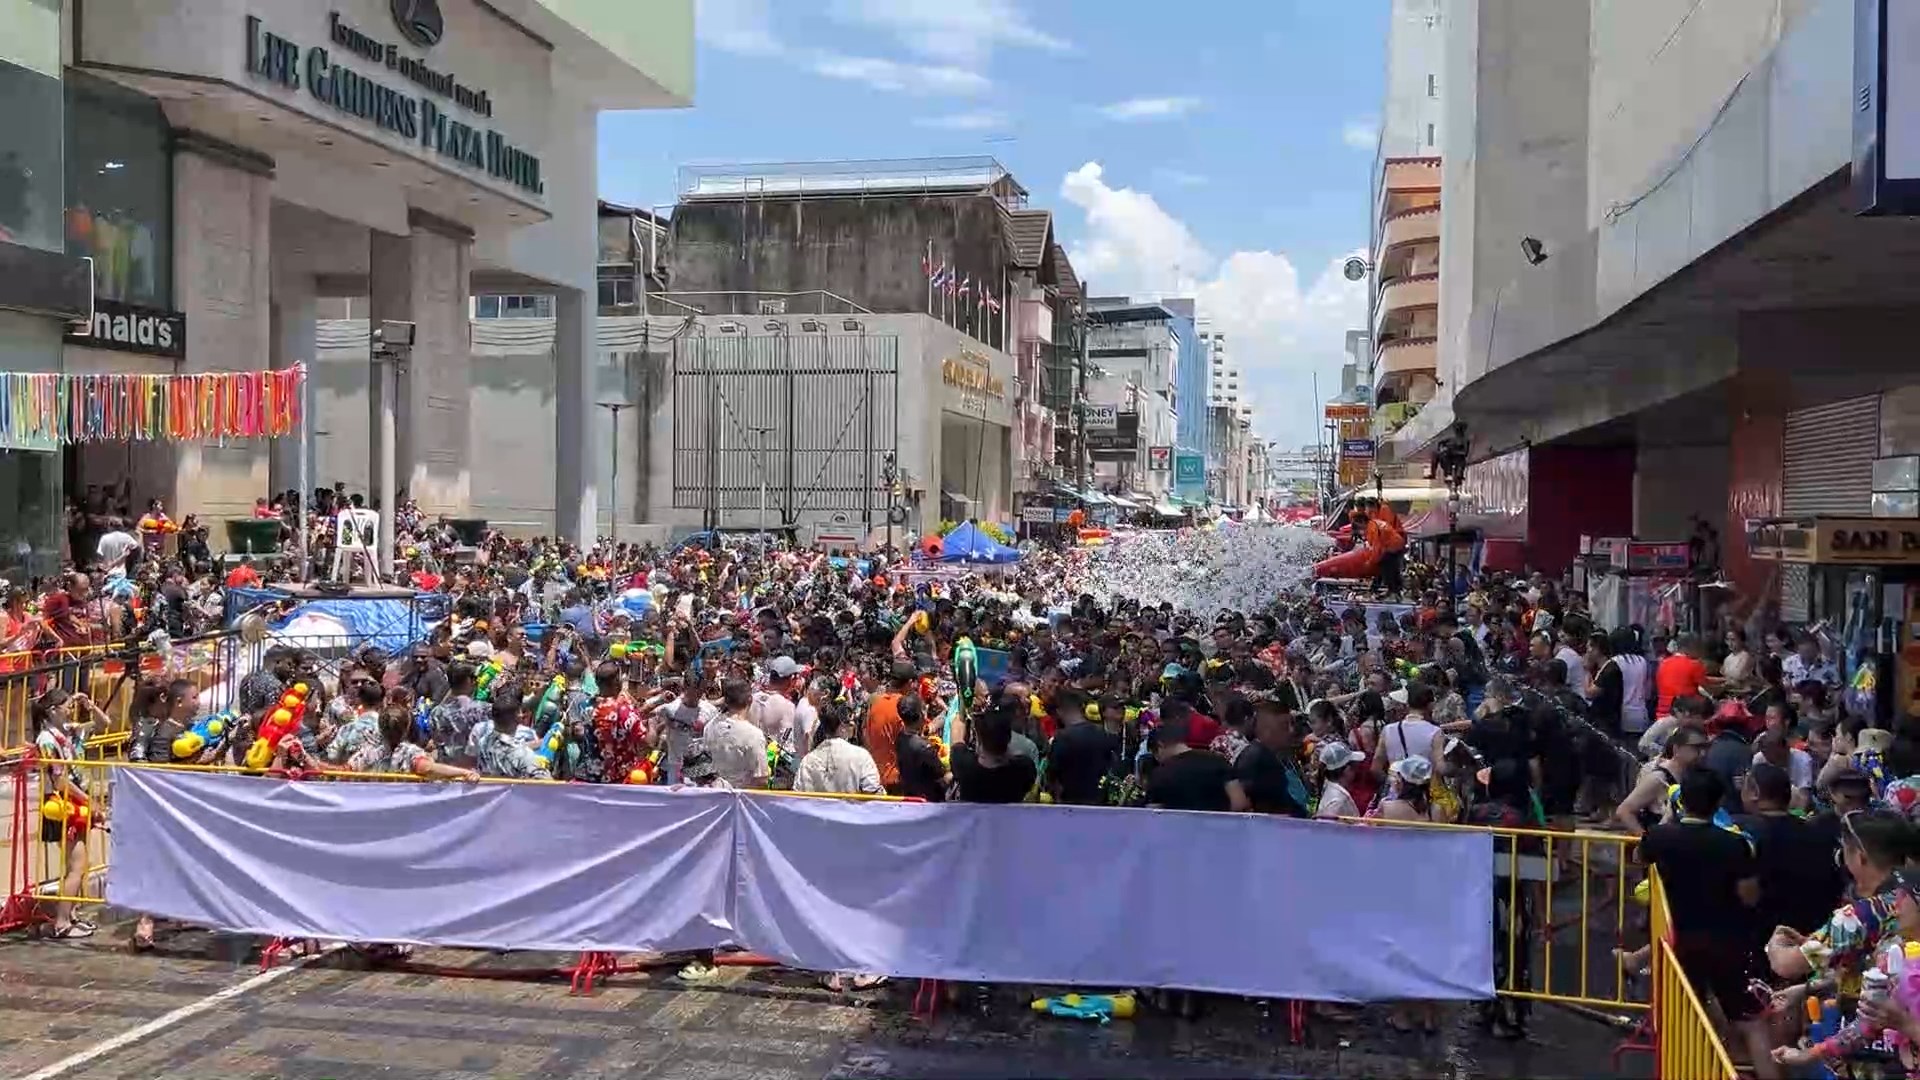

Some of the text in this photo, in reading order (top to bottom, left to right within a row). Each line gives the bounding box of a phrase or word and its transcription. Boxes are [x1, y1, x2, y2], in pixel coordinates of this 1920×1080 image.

[246, 15, 544, 195] LEE GARDENS PLAZA HOTEL
[94, 312, 172, 347] nald's
[1831, 530, 1889, 550] SAN
